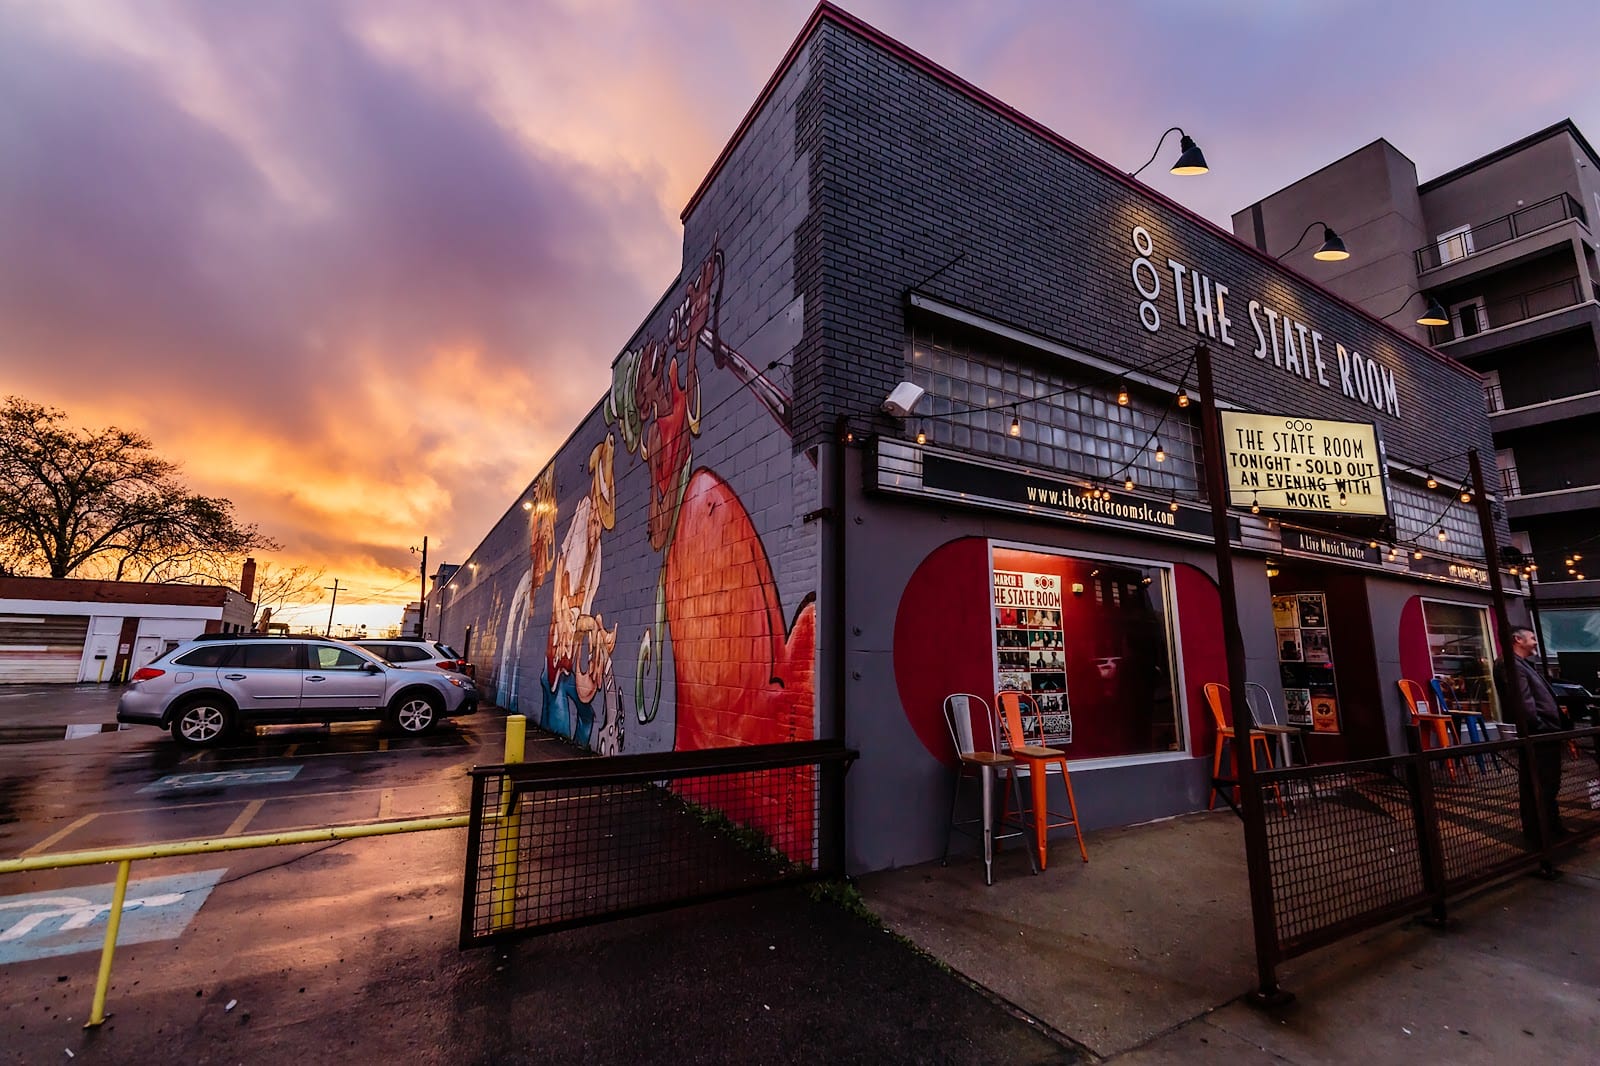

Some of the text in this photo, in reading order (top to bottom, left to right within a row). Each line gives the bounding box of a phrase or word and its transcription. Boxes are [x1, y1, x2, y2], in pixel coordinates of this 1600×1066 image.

[1167, 257, 1401, 418] THE STATE ROOM
[1236, 428, 1364, 459] THE STATE ROOM
[1230, 452, 1291, 472] TONIGHT
[1306, 459, 1342, 475] SOLD
[1347, 463, 1374, 478] OUT
[1241, 471, 1371, 495] AN EVENING WITH
[1027, 486, 1175, 526] www.thestateroomslc.com
[1286, 492, 1332, 509] MOKIE
[1300, 533, 1365, 560] A Live Music Theatre
[994, 573, 1017, 587] MARCH
[994, 588, 1061, 608] HE STATE ROOM
